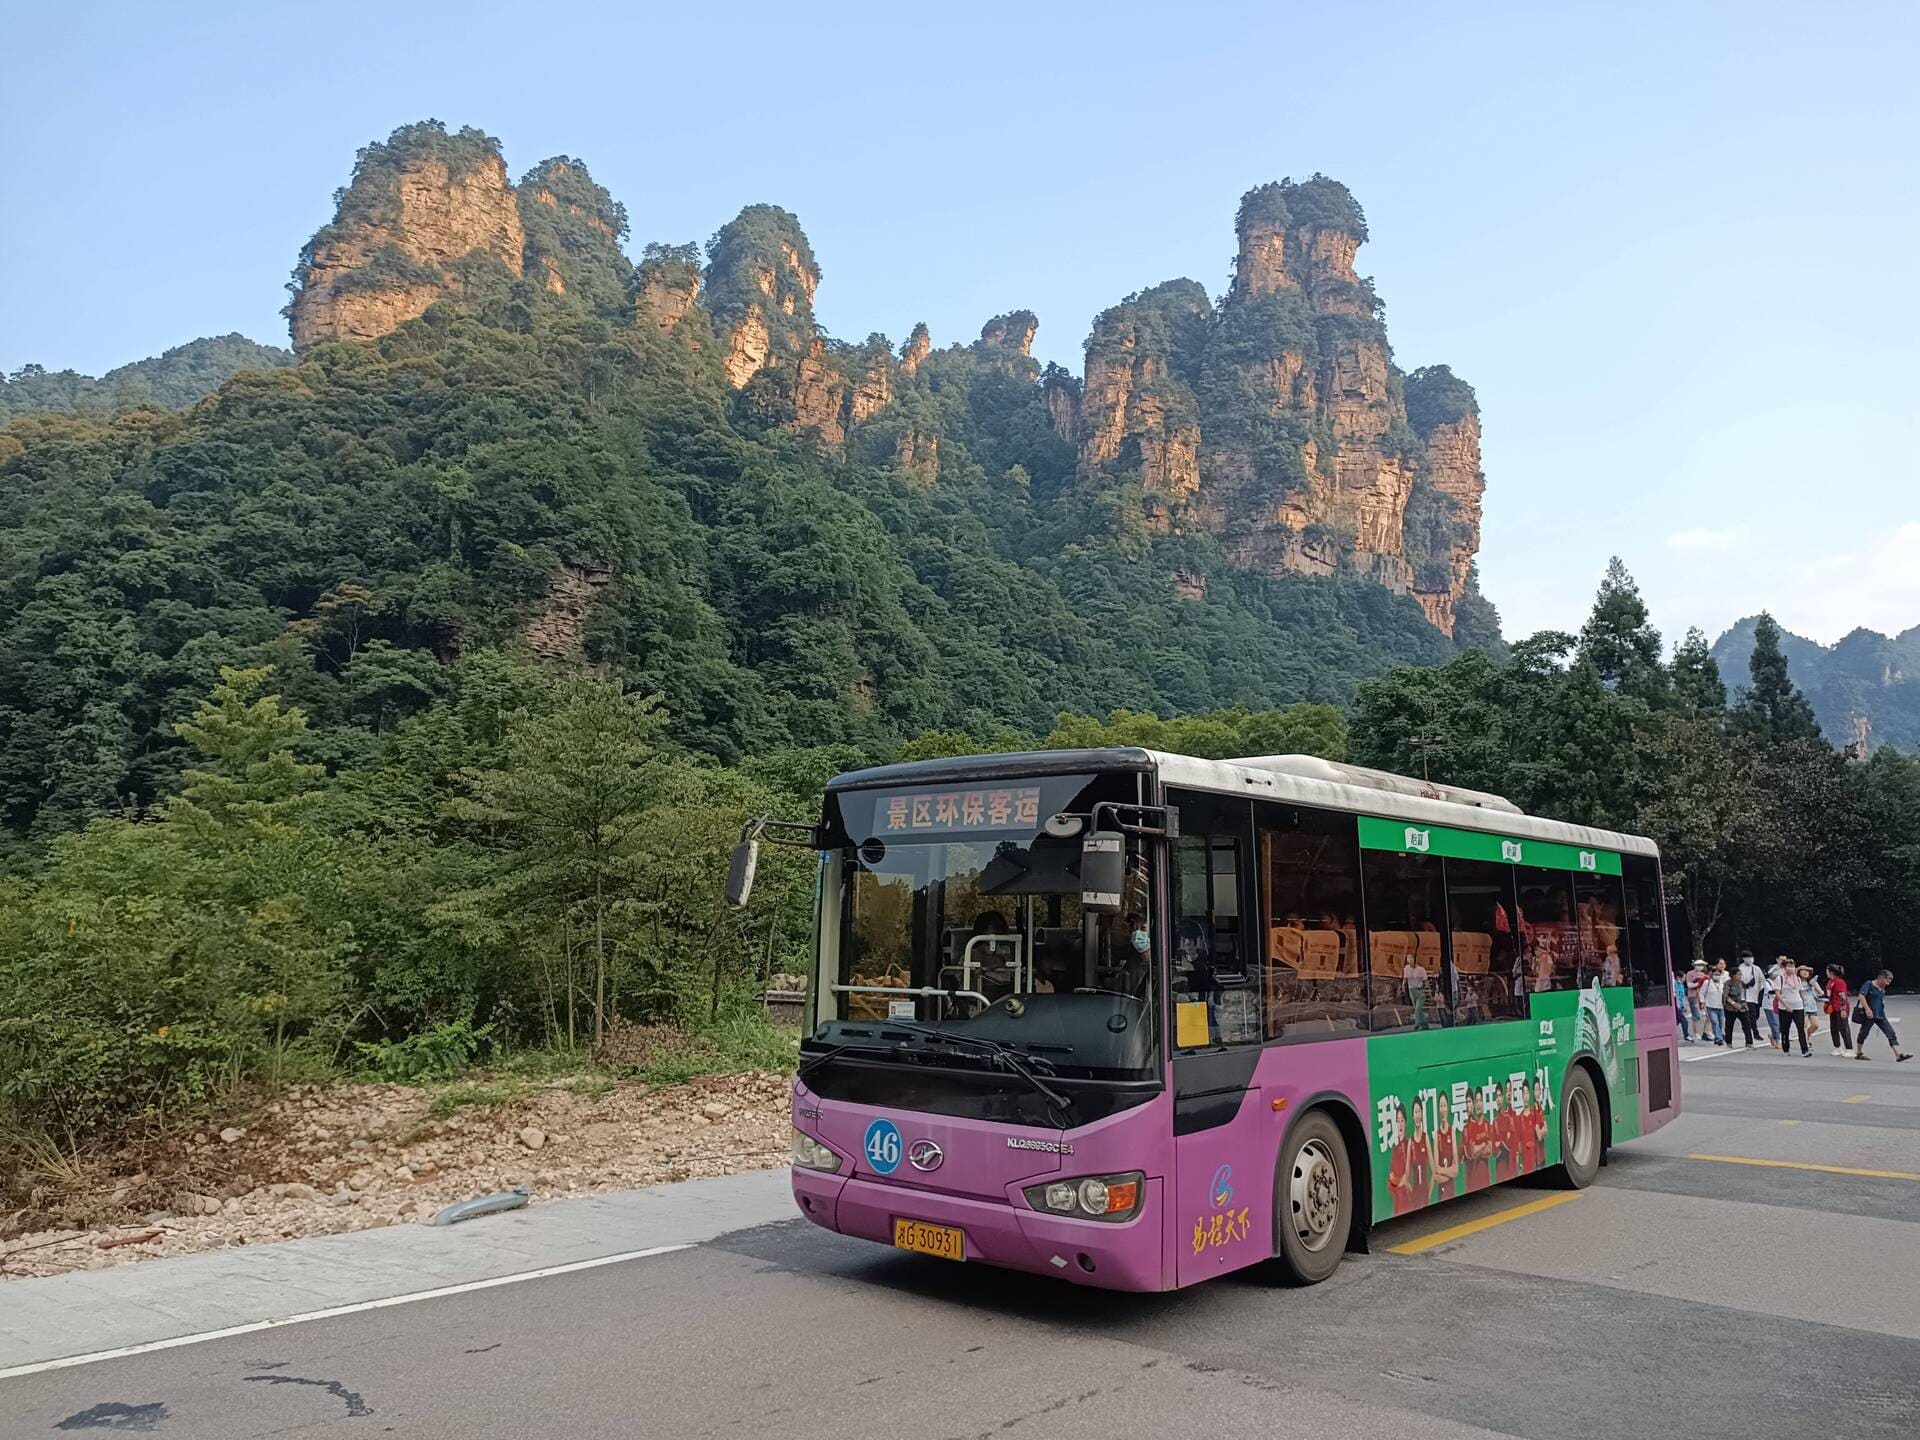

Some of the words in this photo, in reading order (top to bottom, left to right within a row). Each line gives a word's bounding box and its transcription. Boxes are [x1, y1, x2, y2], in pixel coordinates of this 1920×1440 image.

[886, 787, 1041, 830] 景区环保客运
[1377, 1066, 1555, 1152] 我们是中国队
[867, 1129, 898, 1163] 46
